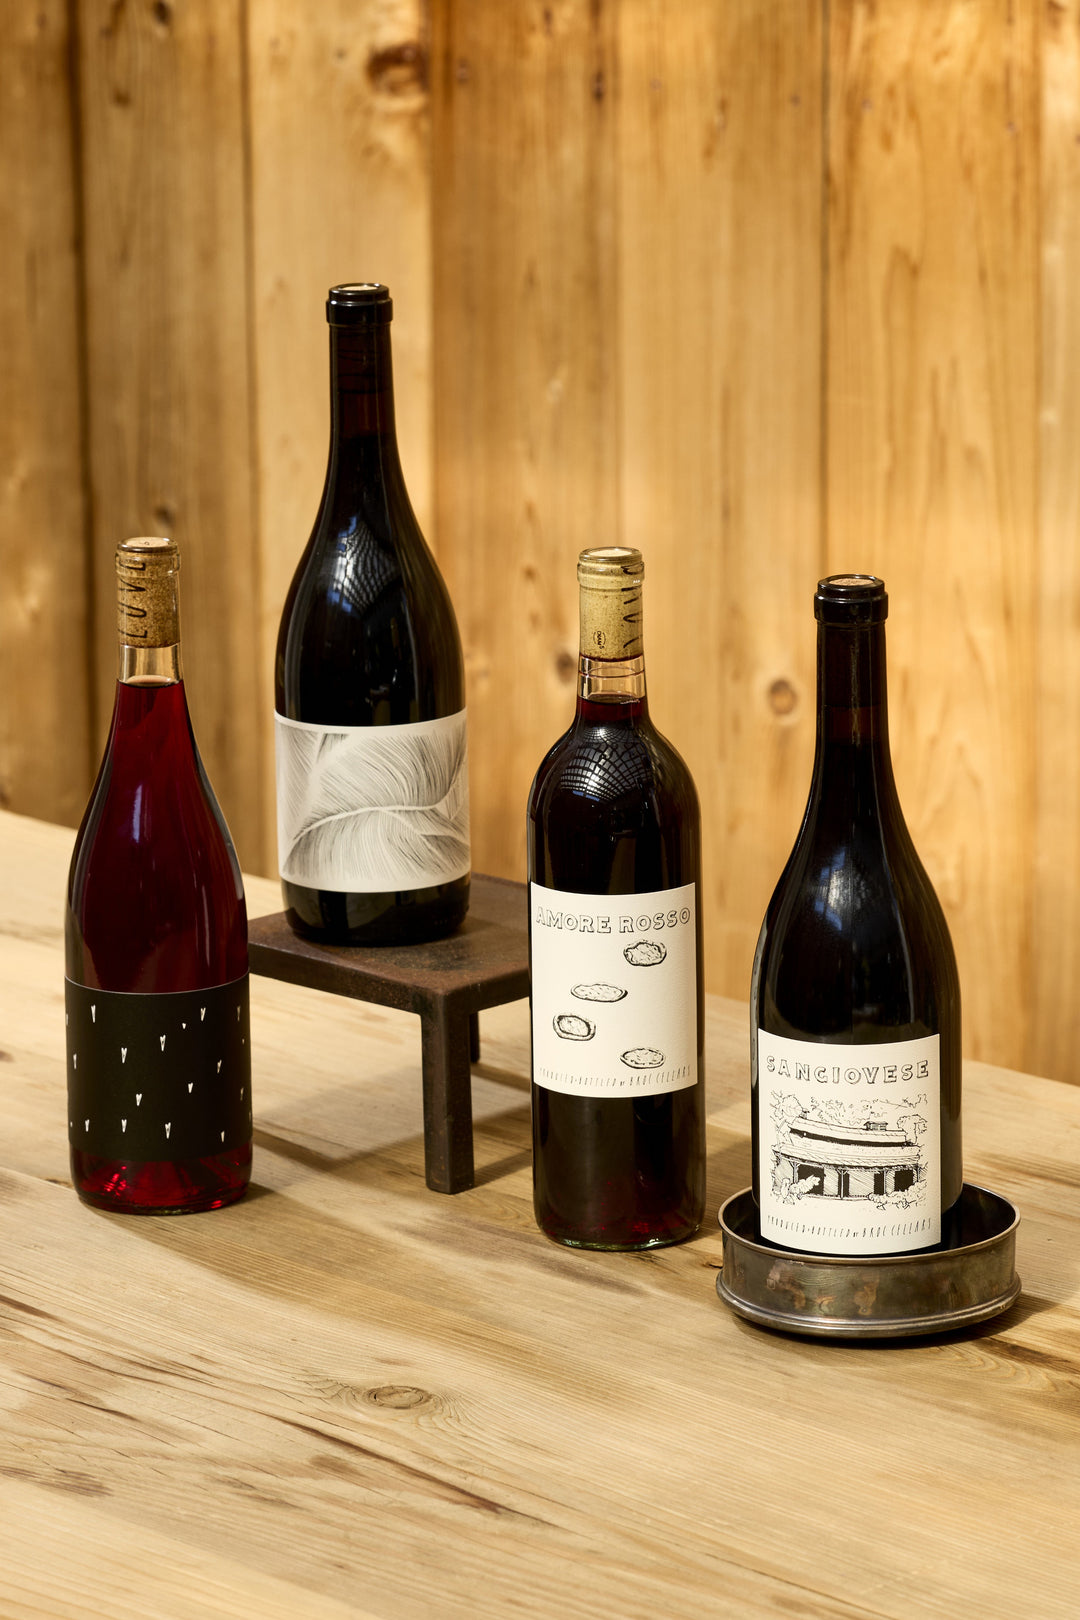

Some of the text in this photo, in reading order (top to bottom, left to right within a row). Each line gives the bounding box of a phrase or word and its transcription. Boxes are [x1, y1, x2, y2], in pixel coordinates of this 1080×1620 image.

[535, 906, 691, 934] AMORE ROSSO
[766, 1055, 929, 1085] SANGIOVESE
